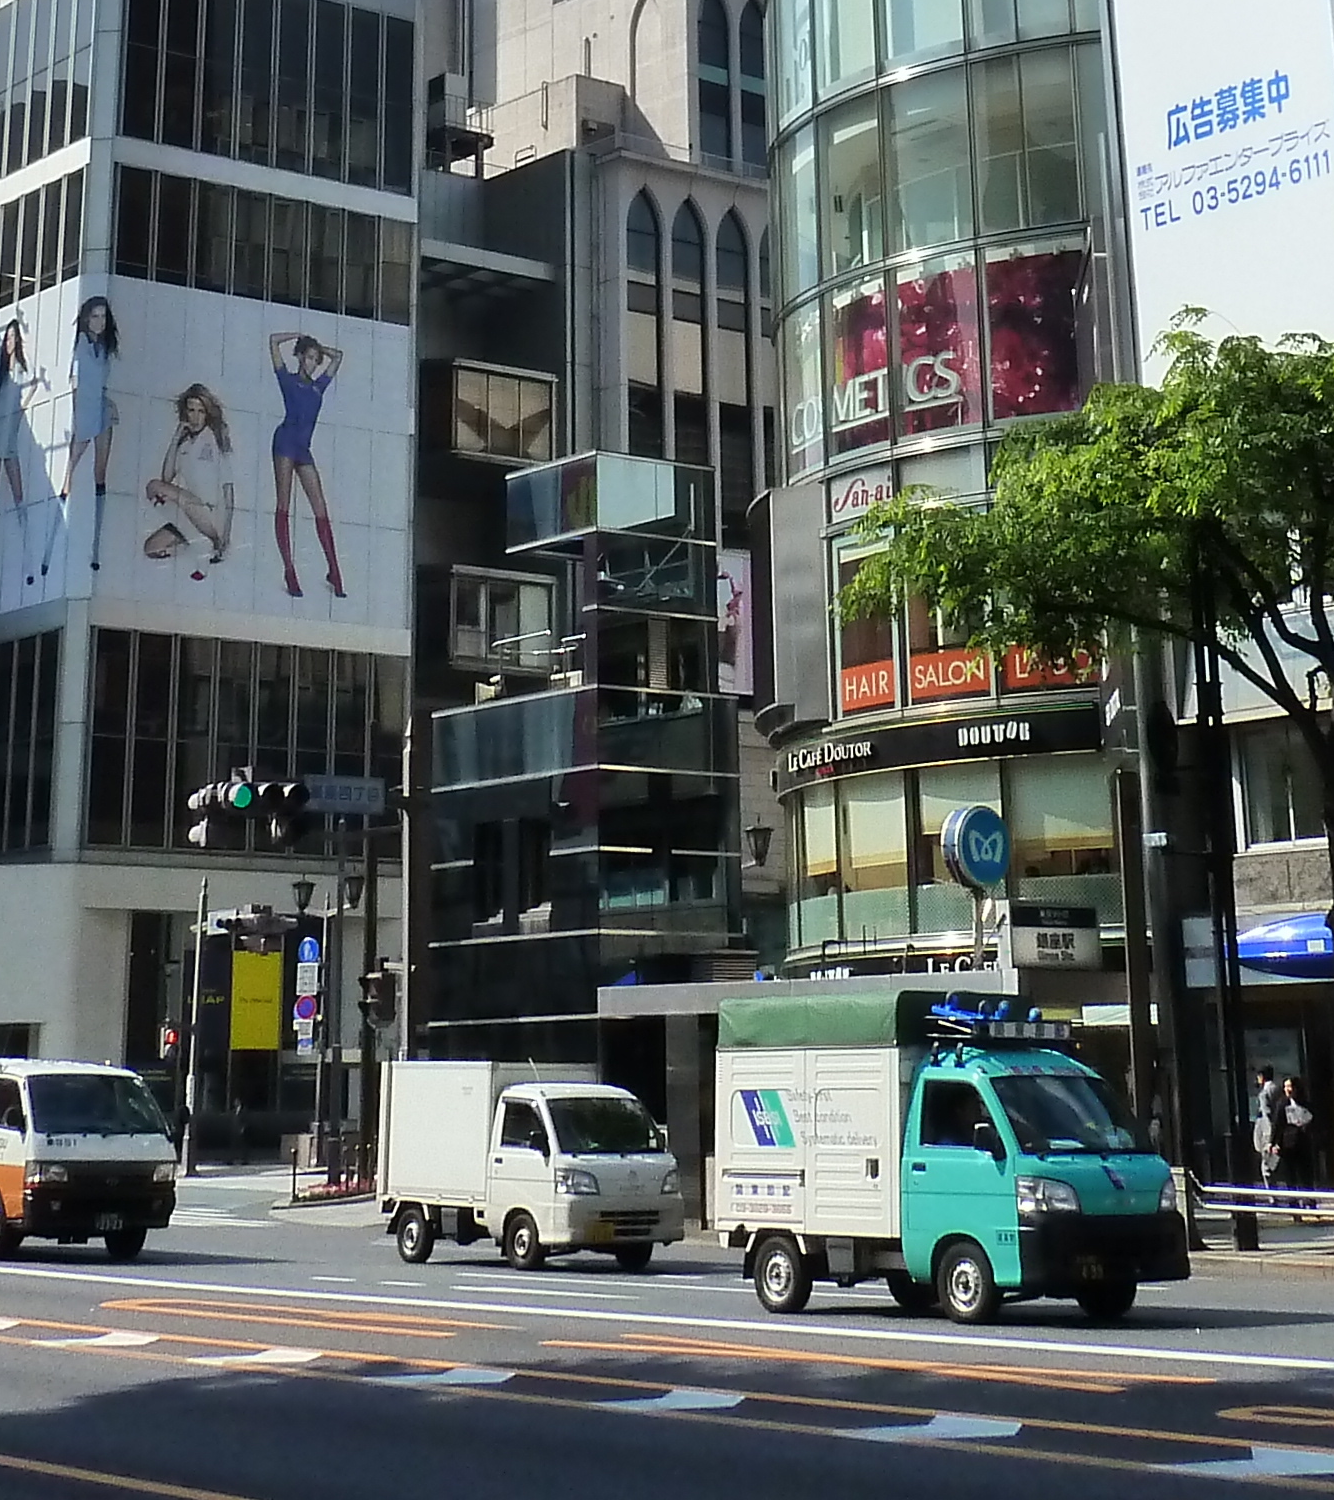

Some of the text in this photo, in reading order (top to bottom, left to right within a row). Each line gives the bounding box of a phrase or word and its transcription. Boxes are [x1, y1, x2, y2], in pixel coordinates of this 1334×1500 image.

[1165, 69, 1292, 151] 広告募集中
[1155, 119, 1332, 196] アルファエンタープライズ
[1139, 148, 1332, 231] TEL 03-5294-6111
[843, 668, 890, 701] HAIR
[913, 651, 986, 689] SALON
[824, 742, 872, 764] DOUTOR
[956, 719, 1032, 748] DOUTOR
